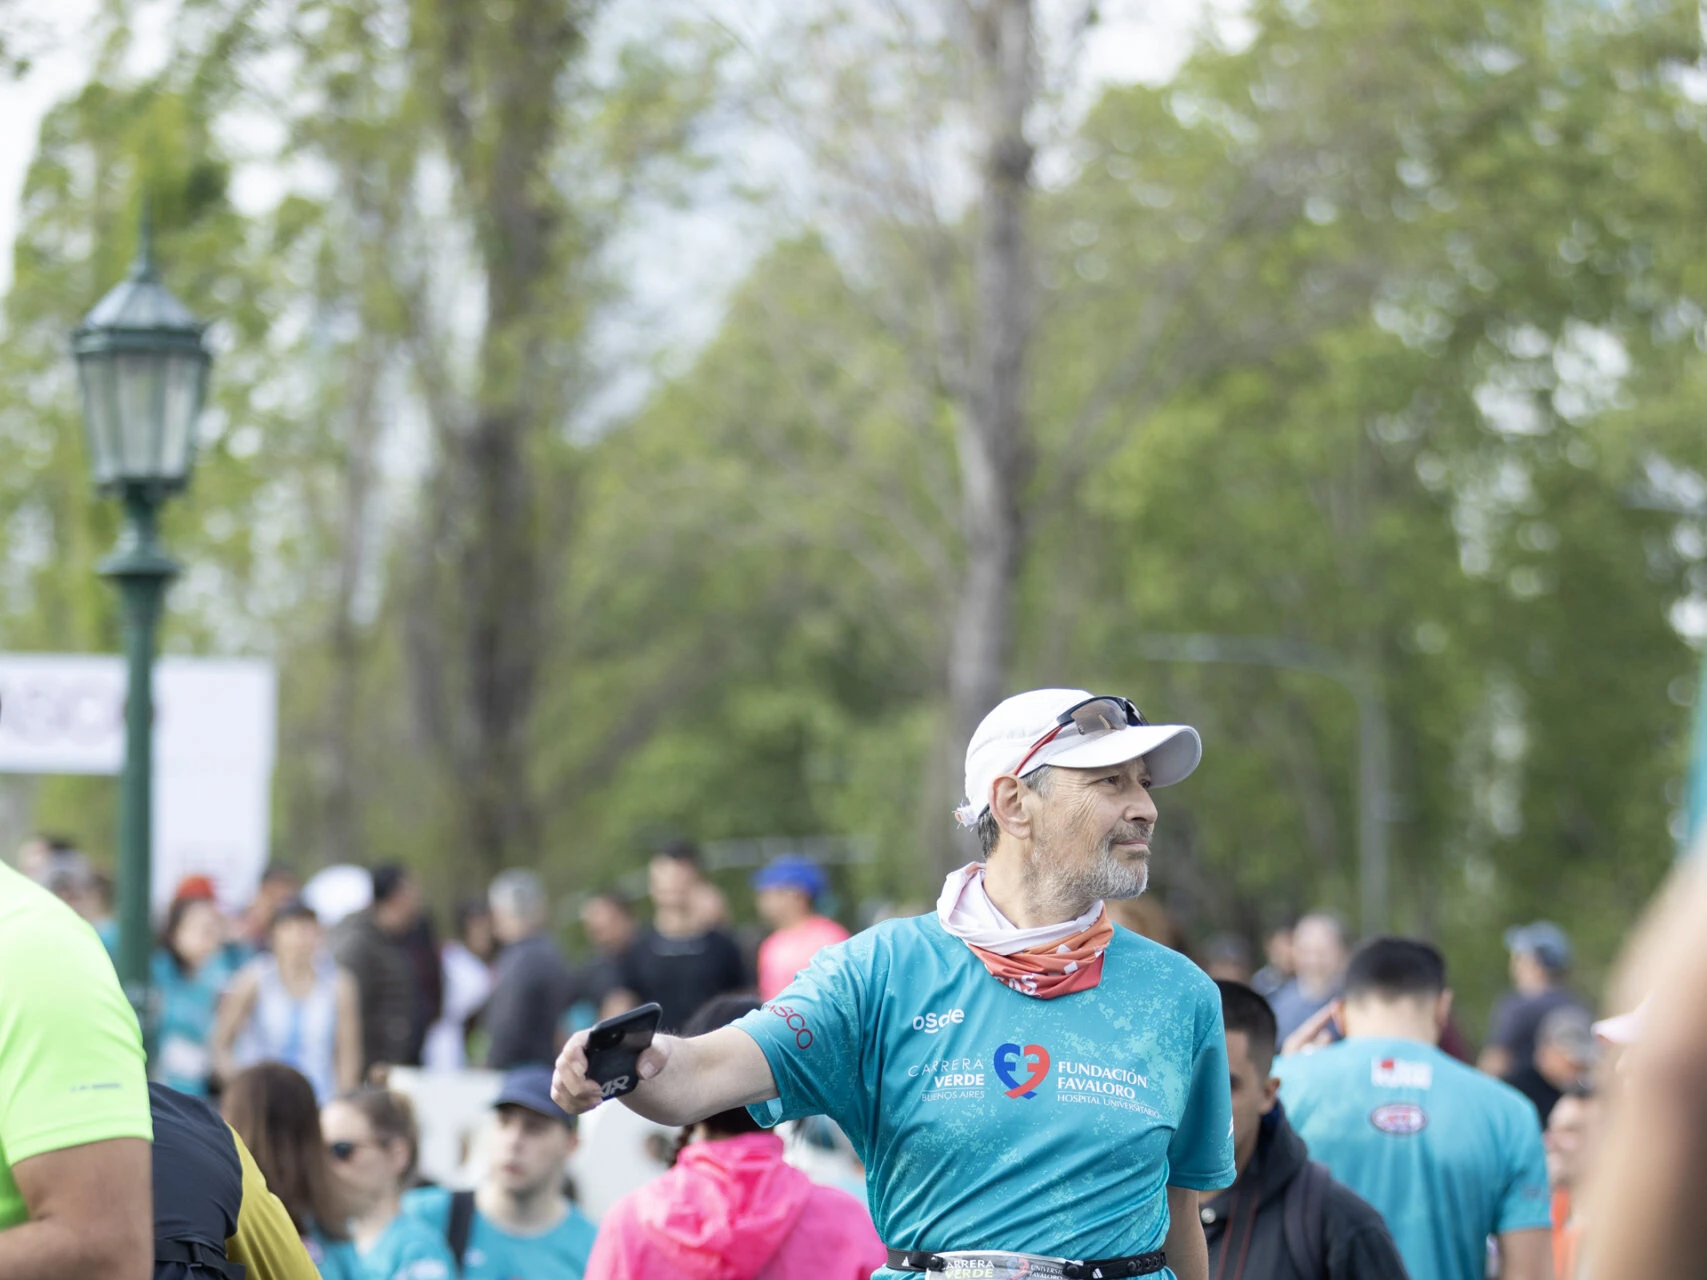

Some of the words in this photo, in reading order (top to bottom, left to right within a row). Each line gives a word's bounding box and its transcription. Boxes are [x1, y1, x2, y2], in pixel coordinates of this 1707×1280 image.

[912, 1008, 965, 1034] osde
[907, 1058, 984, 1077] CARRERA
[1058, 1061, 1147, 1088] FUNDACIÓN
[934, 1074, 985, 1088] VERDE
[1057, 1077, 1135, 1099] FAVALORO
[921, 1091, 957, 1102] BUENOS
[959, 1090, 985, 1099] AIRES
[1057, 1094, 1100, 1105] HOSPITAL
[1103, 1099, 1160, 1119] UNIVERSITARIO
[944, 1259, 995, 1270] ARRERA
[945, 1268, 994, 1279] VERDE
